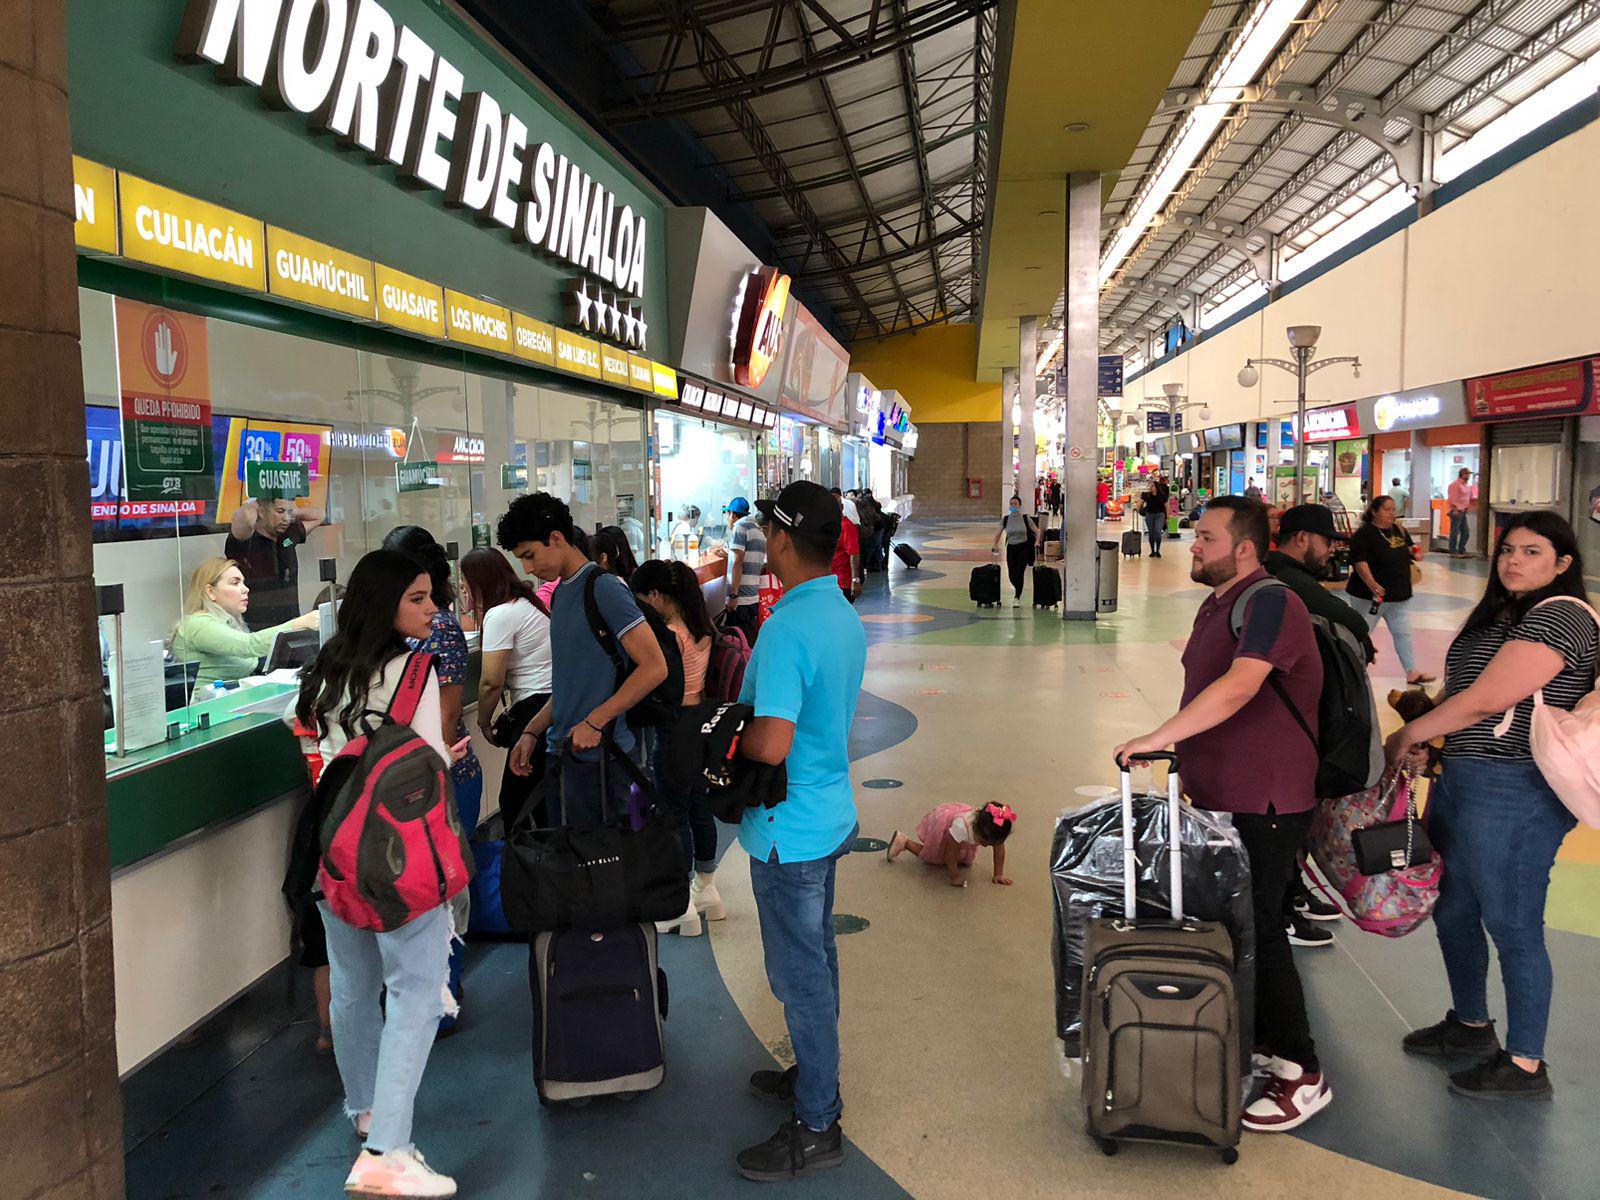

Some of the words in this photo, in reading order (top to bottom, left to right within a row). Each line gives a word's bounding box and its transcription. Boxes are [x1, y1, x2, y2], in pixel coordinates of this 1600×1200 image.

[197, 0, 464, 191] NORTE
[460, 91, 528, 229] DE
[524, 142, 646, 298] SINALOA
[135, 205, 254, 268] CULIACÁN
[276, 249, 370, 302] GUAMÚCHIL
[382, 284, 439, 323] GUASAVE
[450, 305, 472, 331] LOS
[472, 312, 508, 341] MOCHIS
[516, 325, 553, 355] OBREGÓN
[557, 340, 573, 361] SAN
[134, 397, 160, 416] QUEDA
[258, 469, 302, 489] GUASAVE
[131, 504, 149, 517] DE
